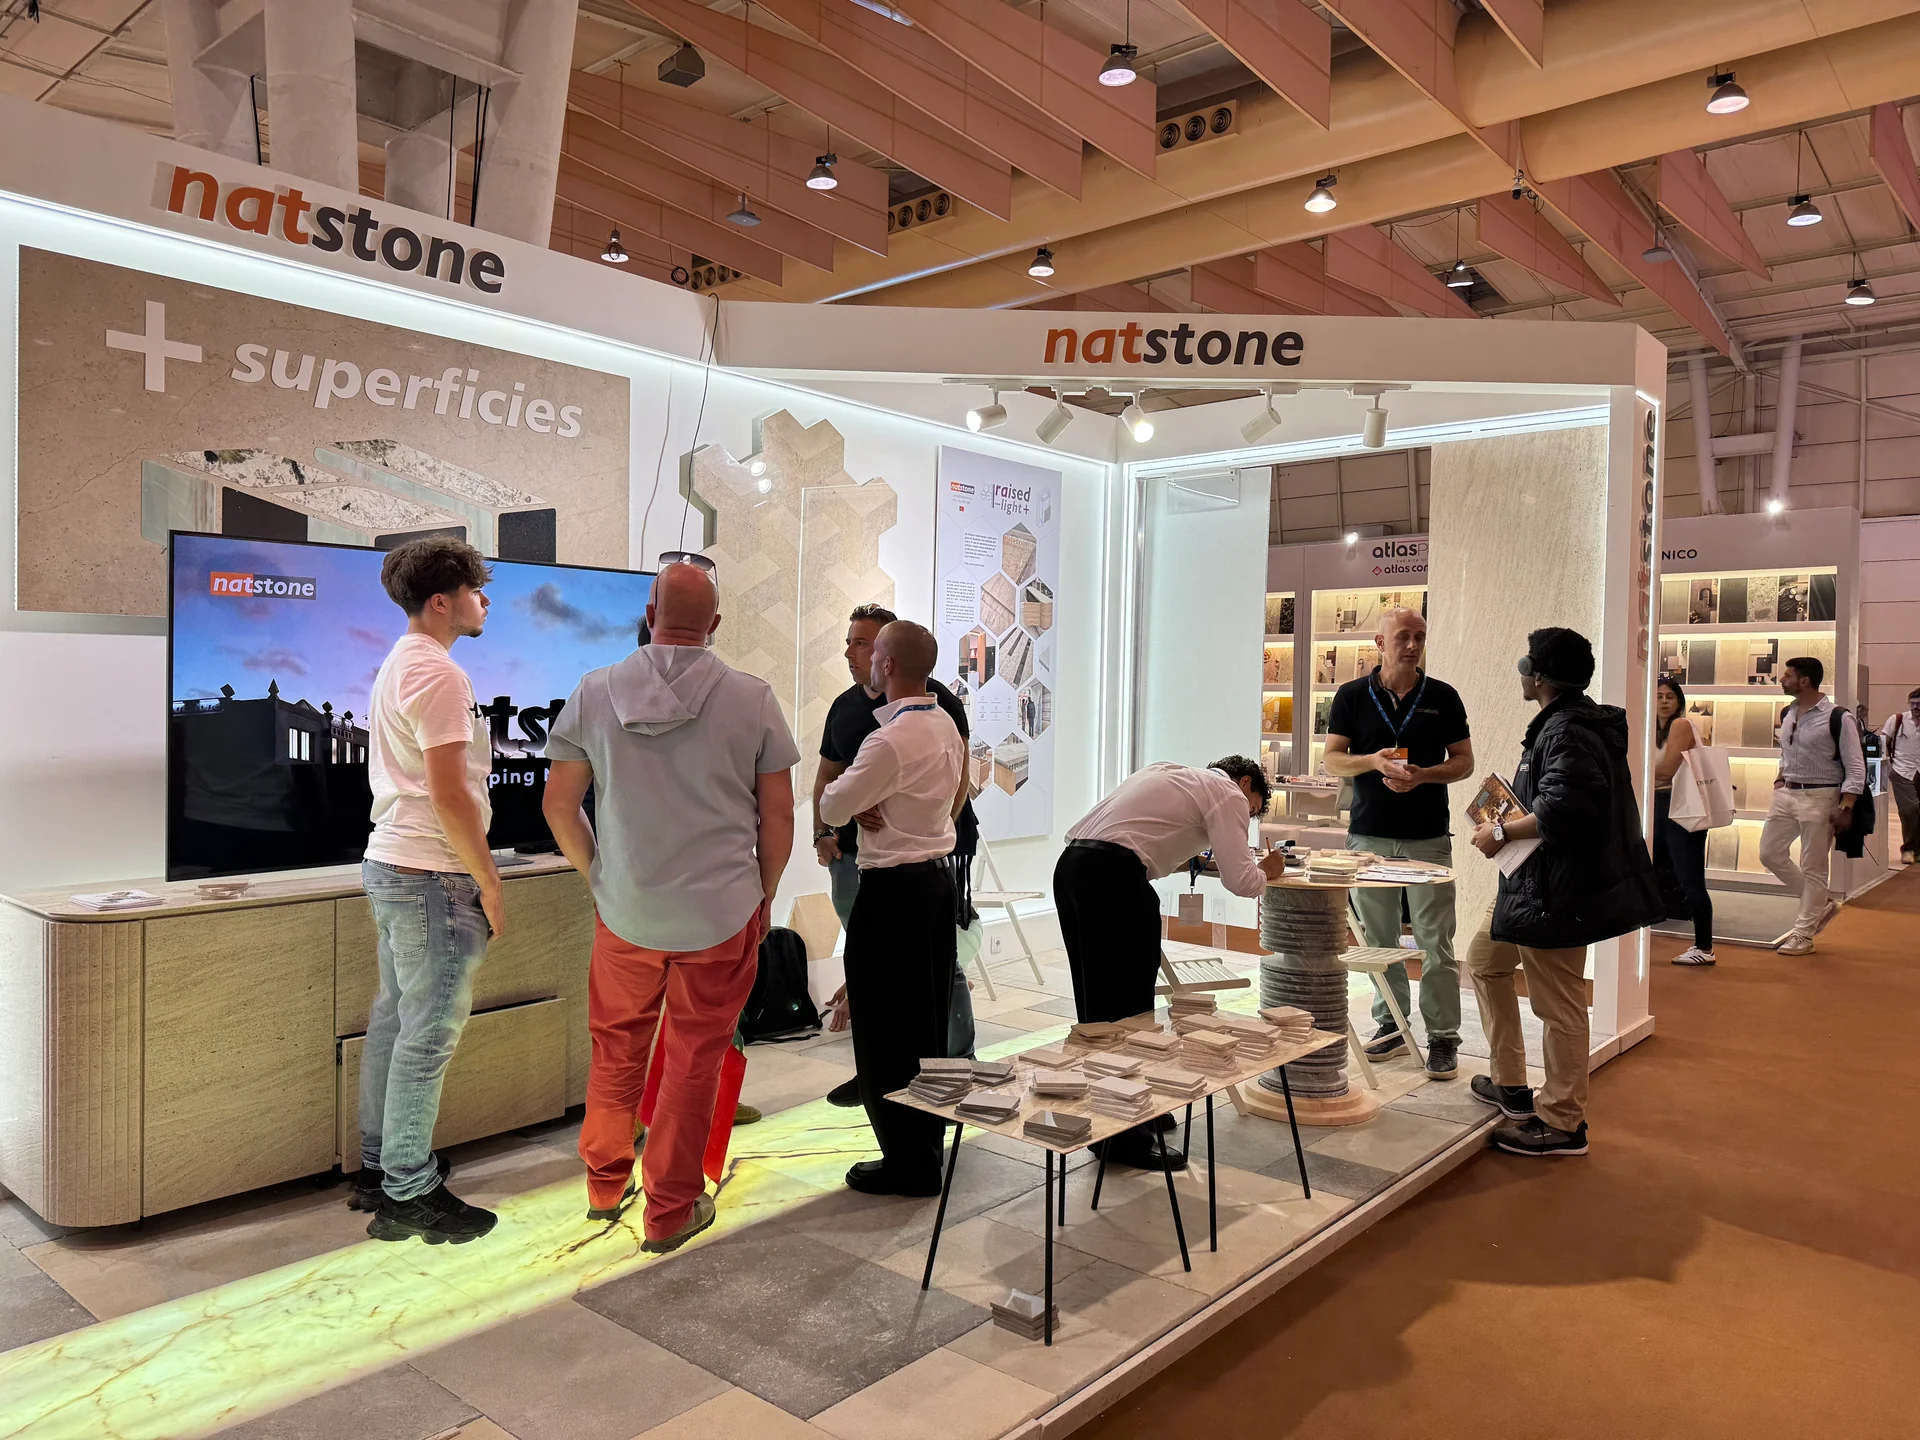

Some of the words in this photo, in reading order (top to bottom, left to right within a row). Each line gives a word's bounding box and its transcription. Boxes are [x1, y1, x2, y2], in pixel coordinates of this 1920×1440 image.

[166, 165, 505, 294] natstone
[1043, 321, 1304, 367] natstone
[230, 342, 584, 439] superficies
[995, 483, 1032, 502] raised
[1384, 564, 1410, 574] atlas
[213, 576, 315, 597] natstone
